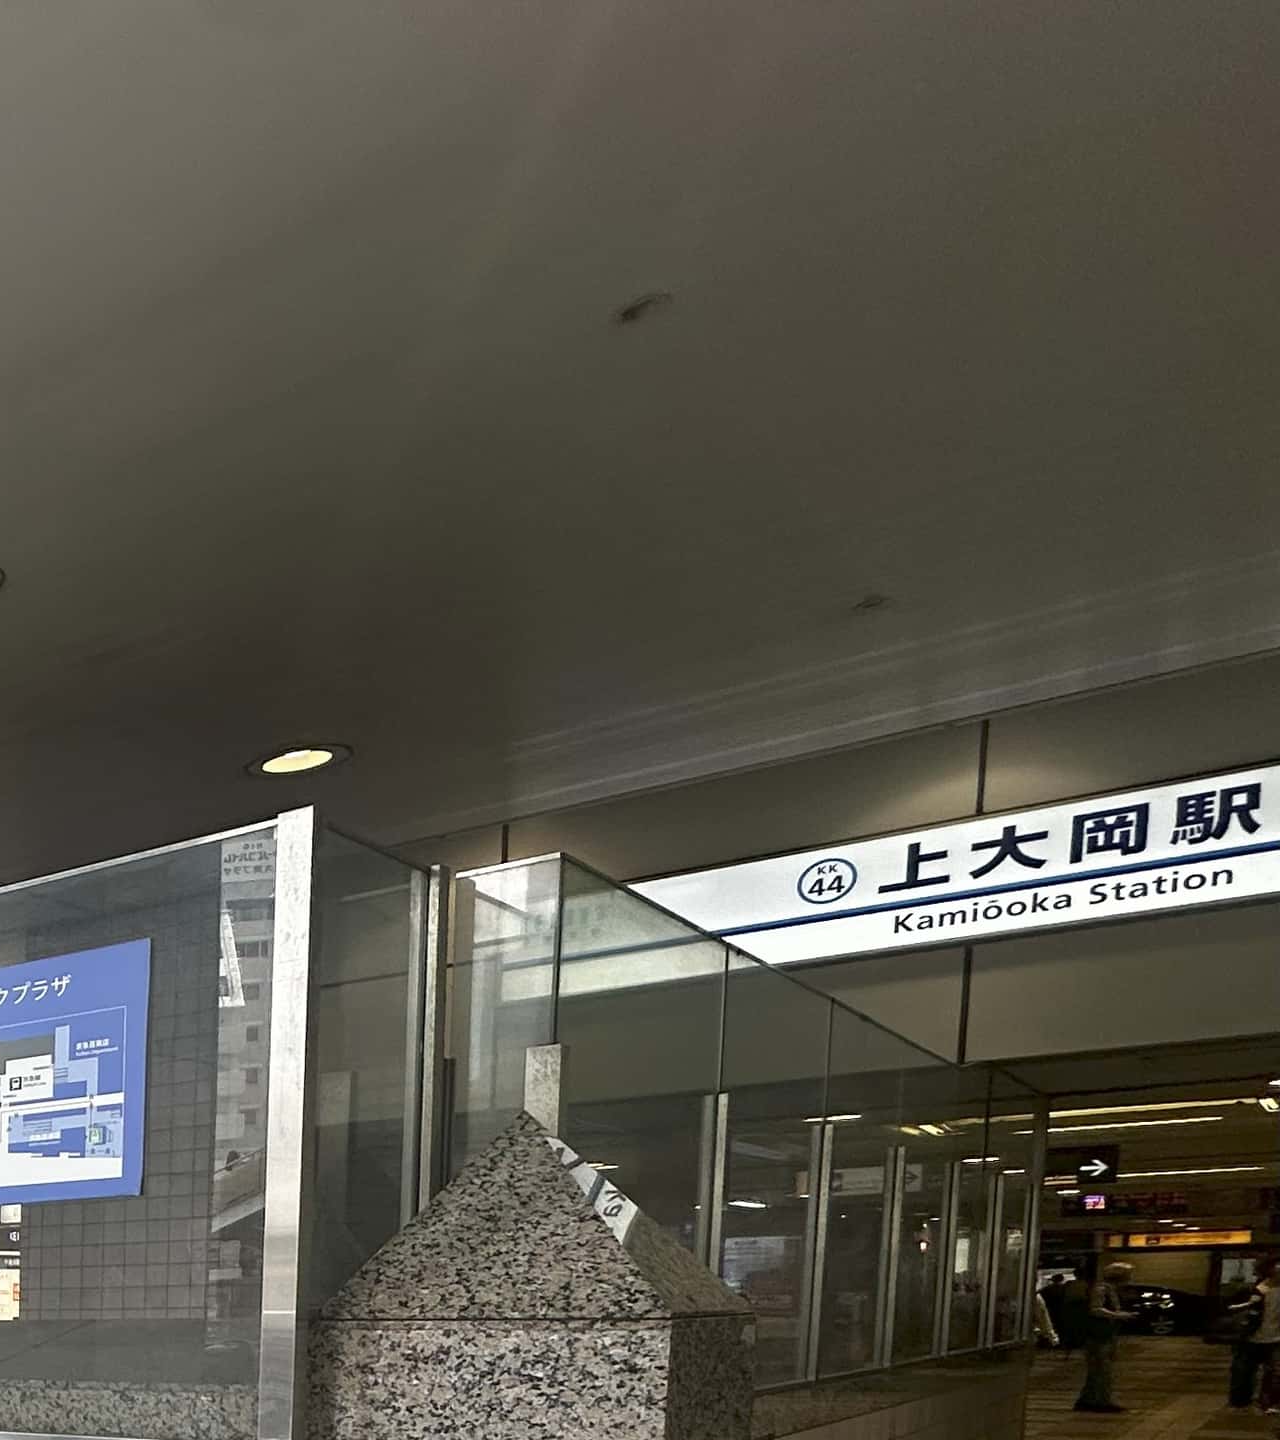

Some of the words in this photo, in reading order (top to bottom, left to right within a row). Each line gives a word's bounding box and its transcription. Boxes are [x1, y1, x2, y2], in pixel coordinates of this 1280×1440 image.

[878, 782, 1263, 895] 上大岡駅
[808, 872, 846, 898] 44
[816, 864, 839, 875] KK
[893, 891, 1073, 934] Kamiōoka
[1088, 865, 1236, 907] Station
